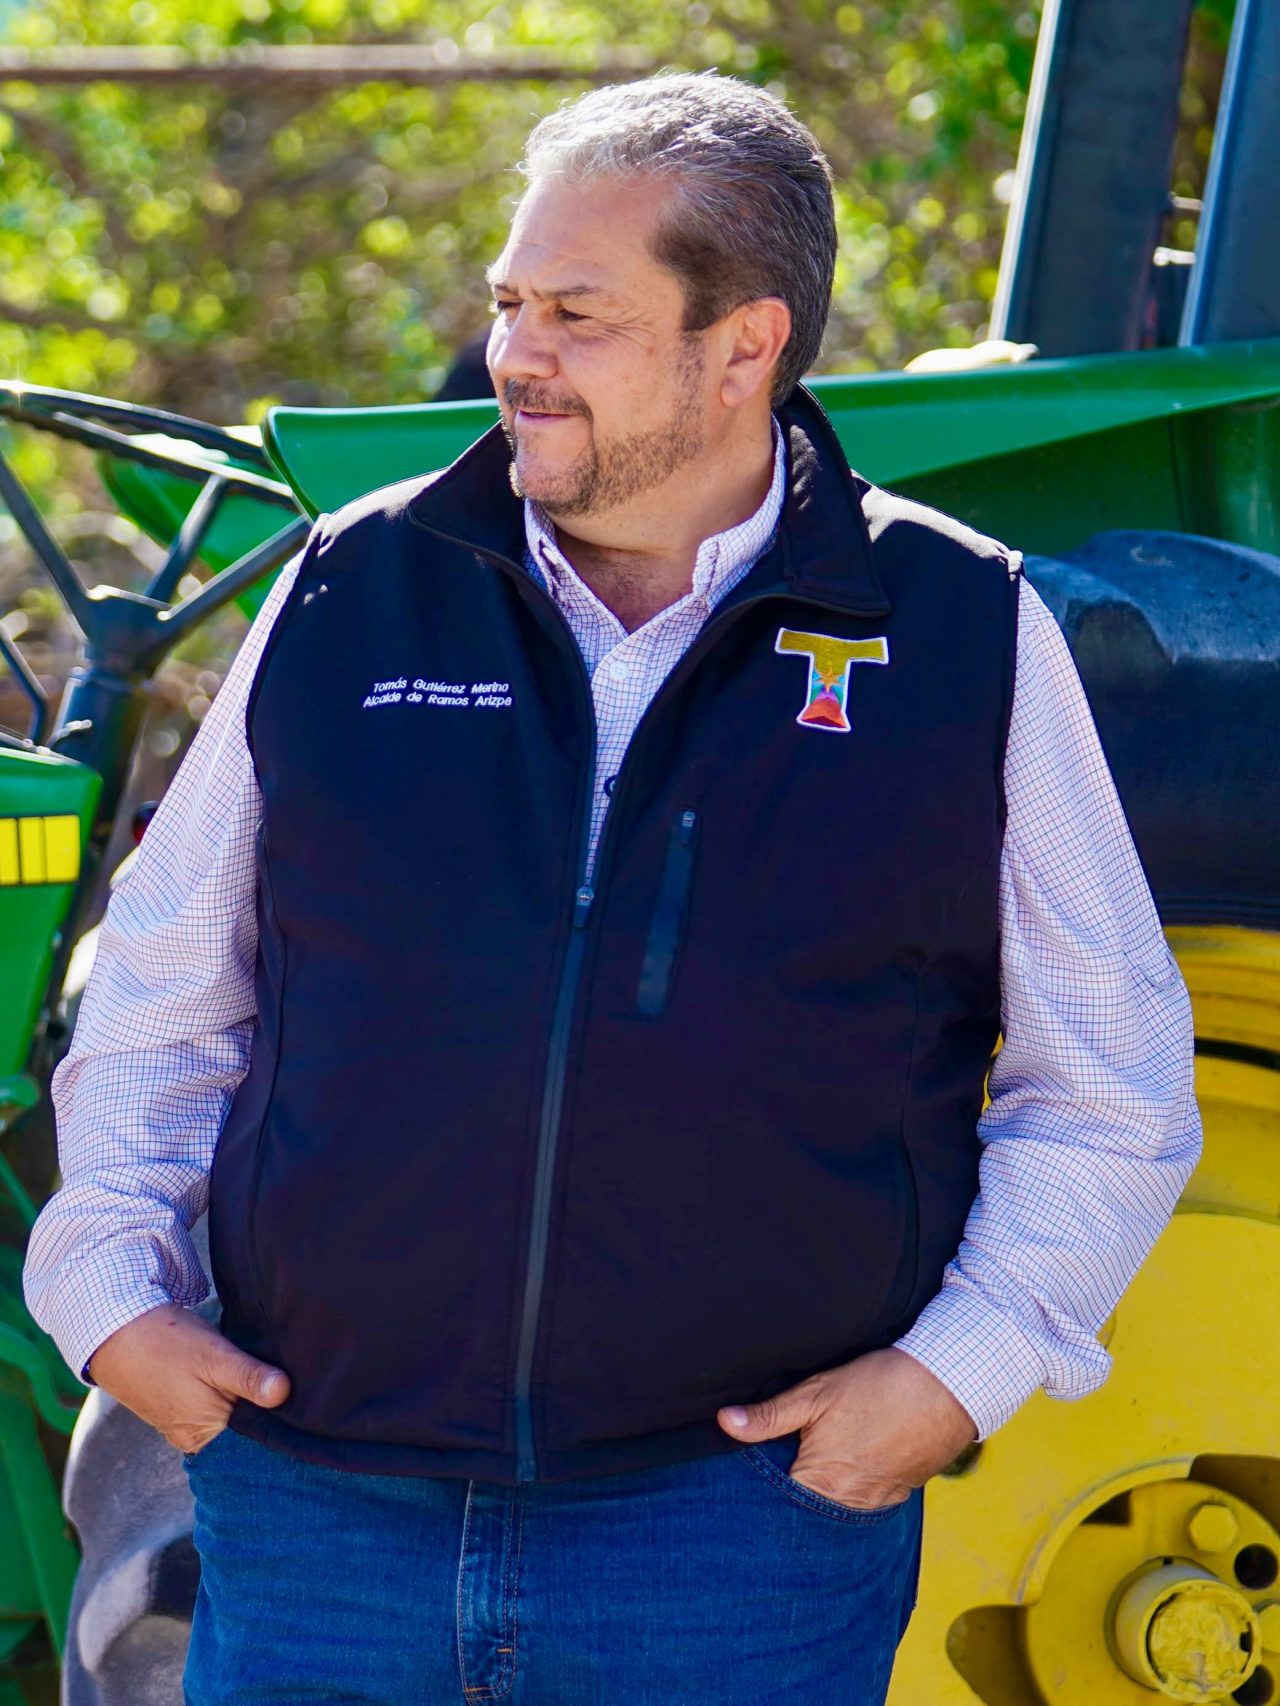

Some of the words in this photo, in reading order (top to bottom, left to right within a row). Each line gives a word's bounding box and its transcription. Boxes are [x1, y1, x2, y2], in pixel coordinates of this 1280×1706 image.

[374, 677, 407, 693] Tomás
[413, 679, 466, 693] Gutiérrez
[471, 682, 509, 694] Merino
[363, 692, 401, 707] Alcalde
[406, 692, 422, 702] de
[428, 694, 469, 706] Ramos
[474, 695, 512, 708] Arizpe
